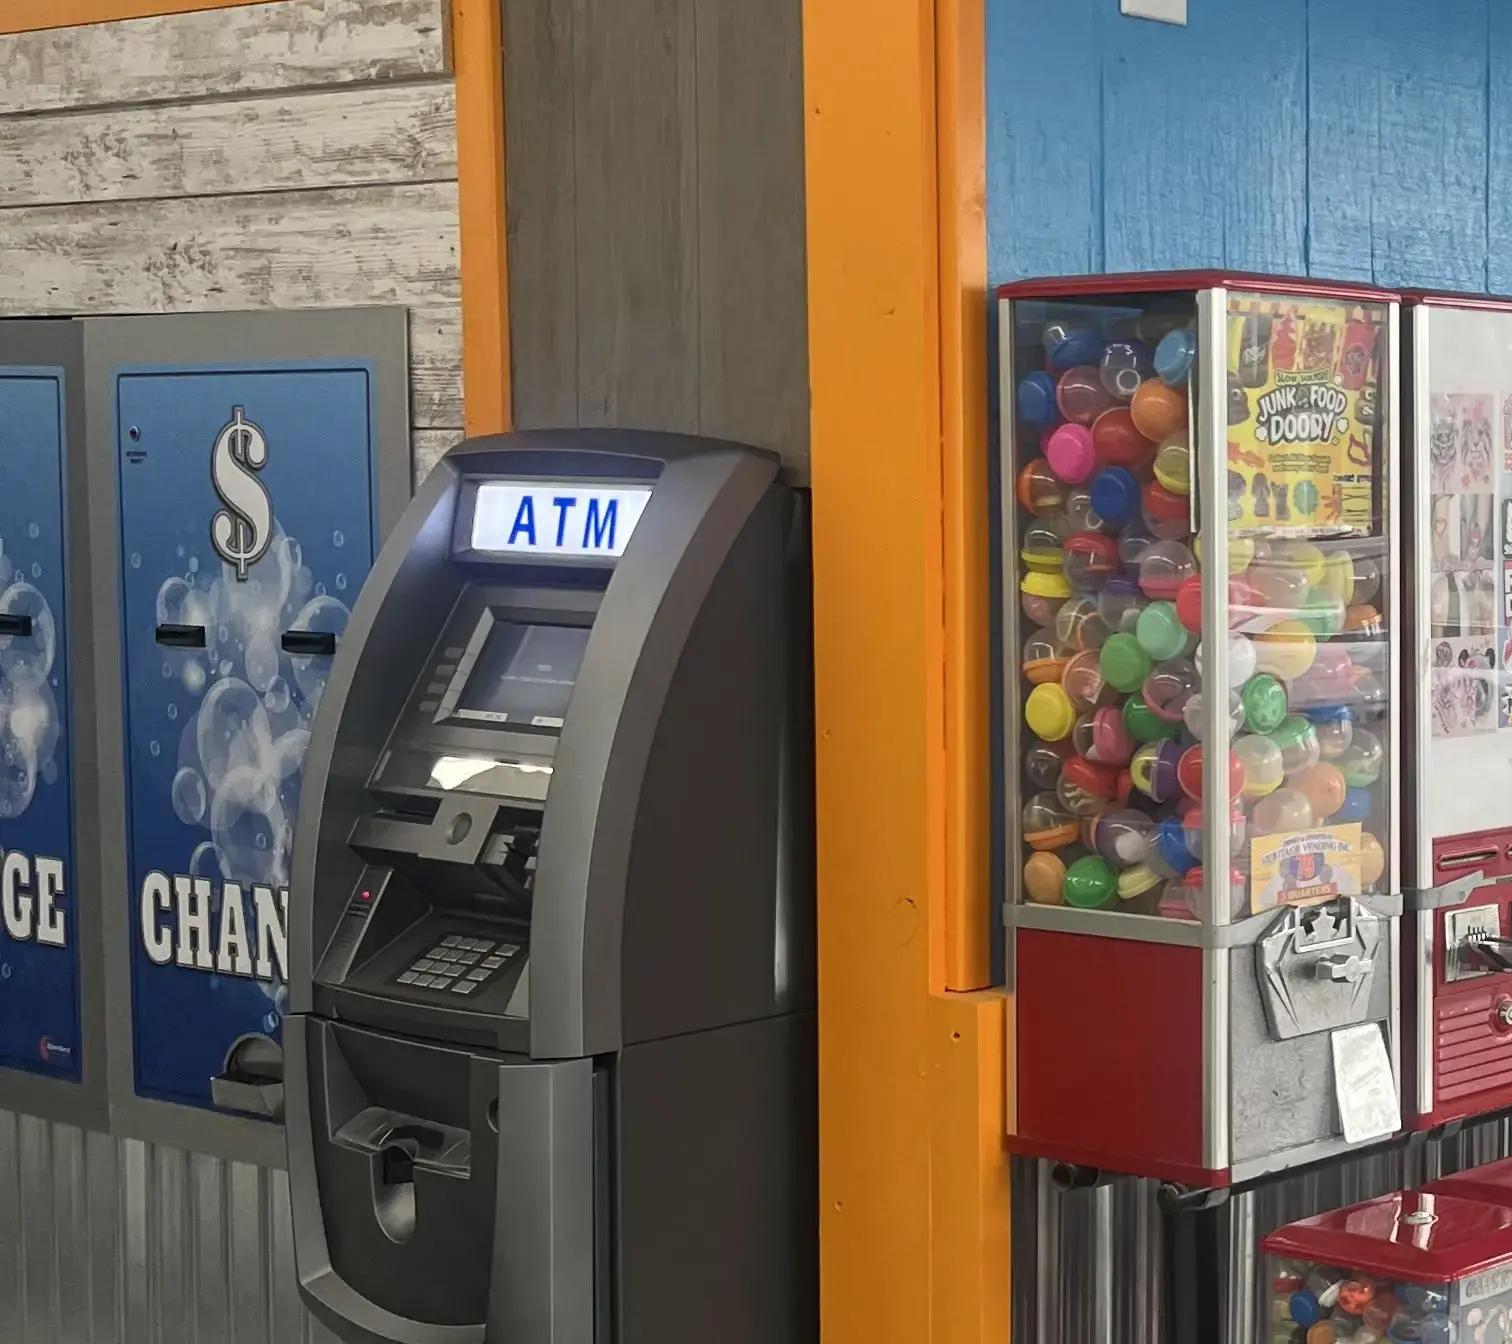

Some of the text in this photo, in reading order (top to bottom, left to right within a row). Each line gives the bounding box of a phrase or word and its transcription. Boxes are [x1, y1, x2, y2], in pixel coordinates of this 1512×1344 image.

[1258, 385, 1347, 423] JUNK FOOD
[1270, 411, 1335, 443] DOODY
[507, 495, 618, 550] ATM
[1287, 886, 1332, 900] QUARTERS
